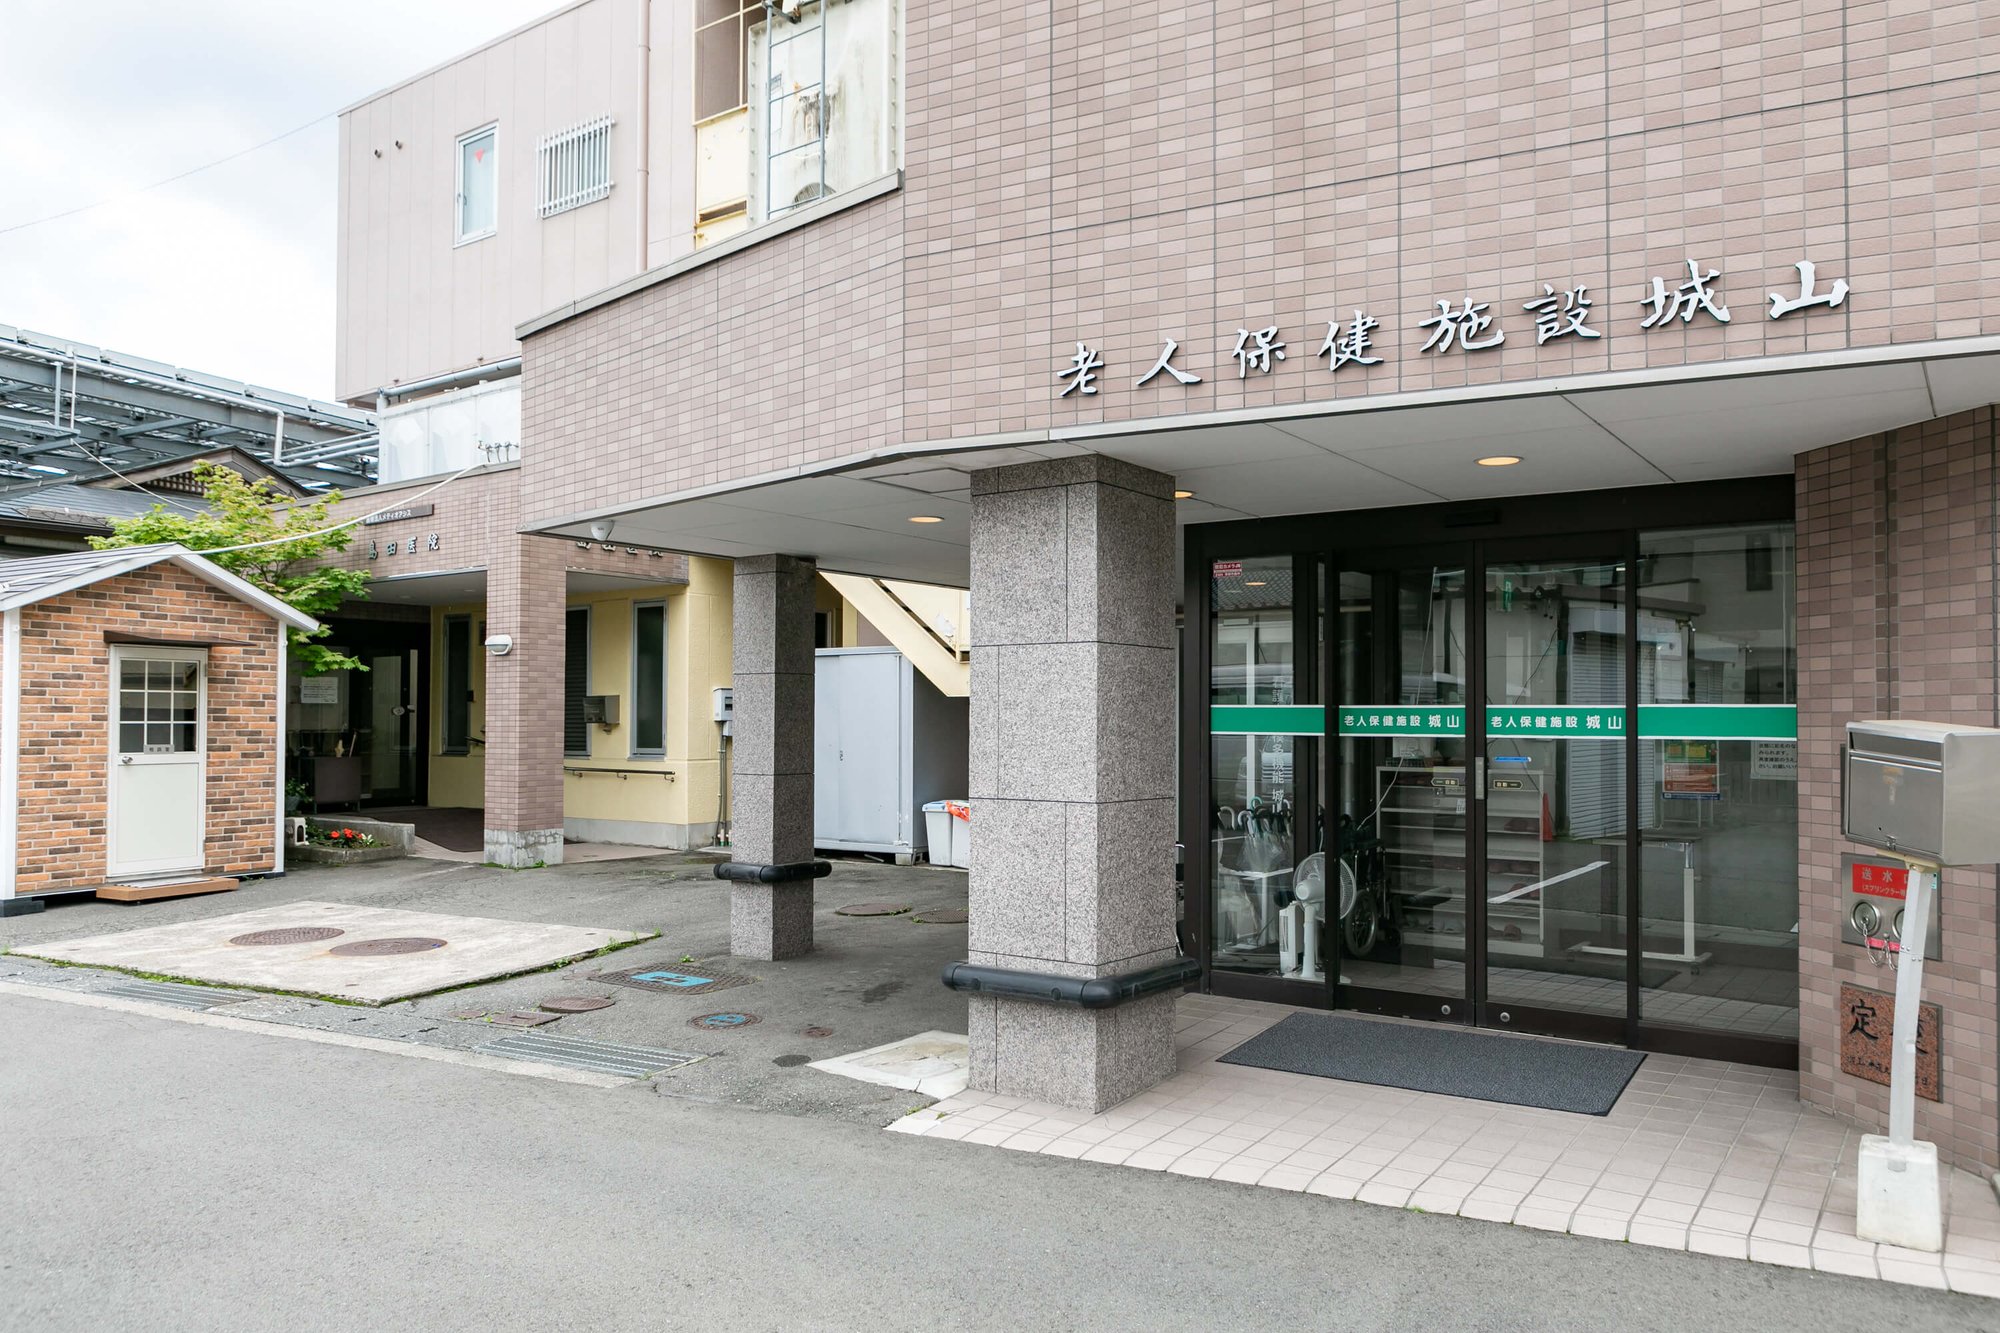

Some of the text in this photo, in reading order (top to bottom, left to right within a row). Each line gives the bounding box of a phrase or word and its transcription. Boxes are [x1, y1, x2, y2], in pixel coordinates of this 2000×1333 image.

[1056, 259, 1849, 397] 老人保健施設城山
